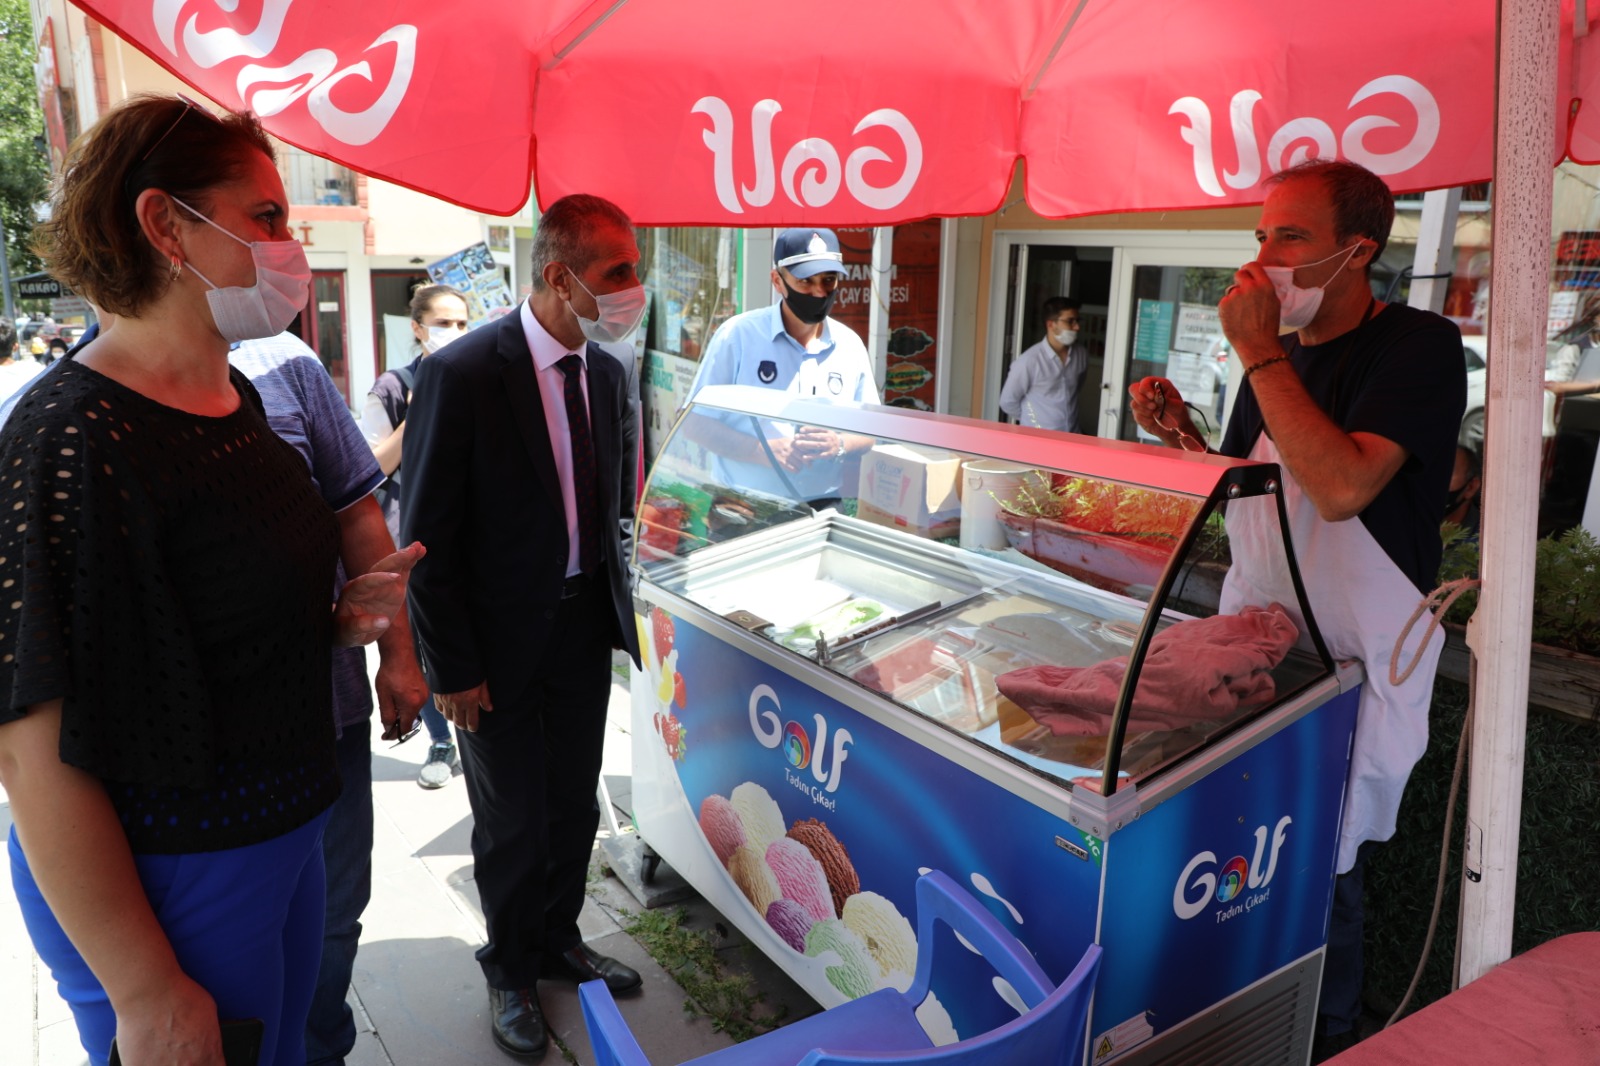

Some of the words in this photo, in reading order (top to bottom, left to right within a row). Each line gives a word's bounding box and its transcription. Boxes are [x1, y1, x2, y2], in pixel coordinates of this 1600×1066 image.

[20, 282, 59, 295] KAKAO
[839, 286, 862, 308] ÇAY
[749, 683, 854, 793] Golf
[810, 786, 836, 813] Çıkar!
[1085, 834, 1101, 857] HC
[1173, 815, 1292, 920] Golf
[1245, 887, 1271, 913] Çıkar!
